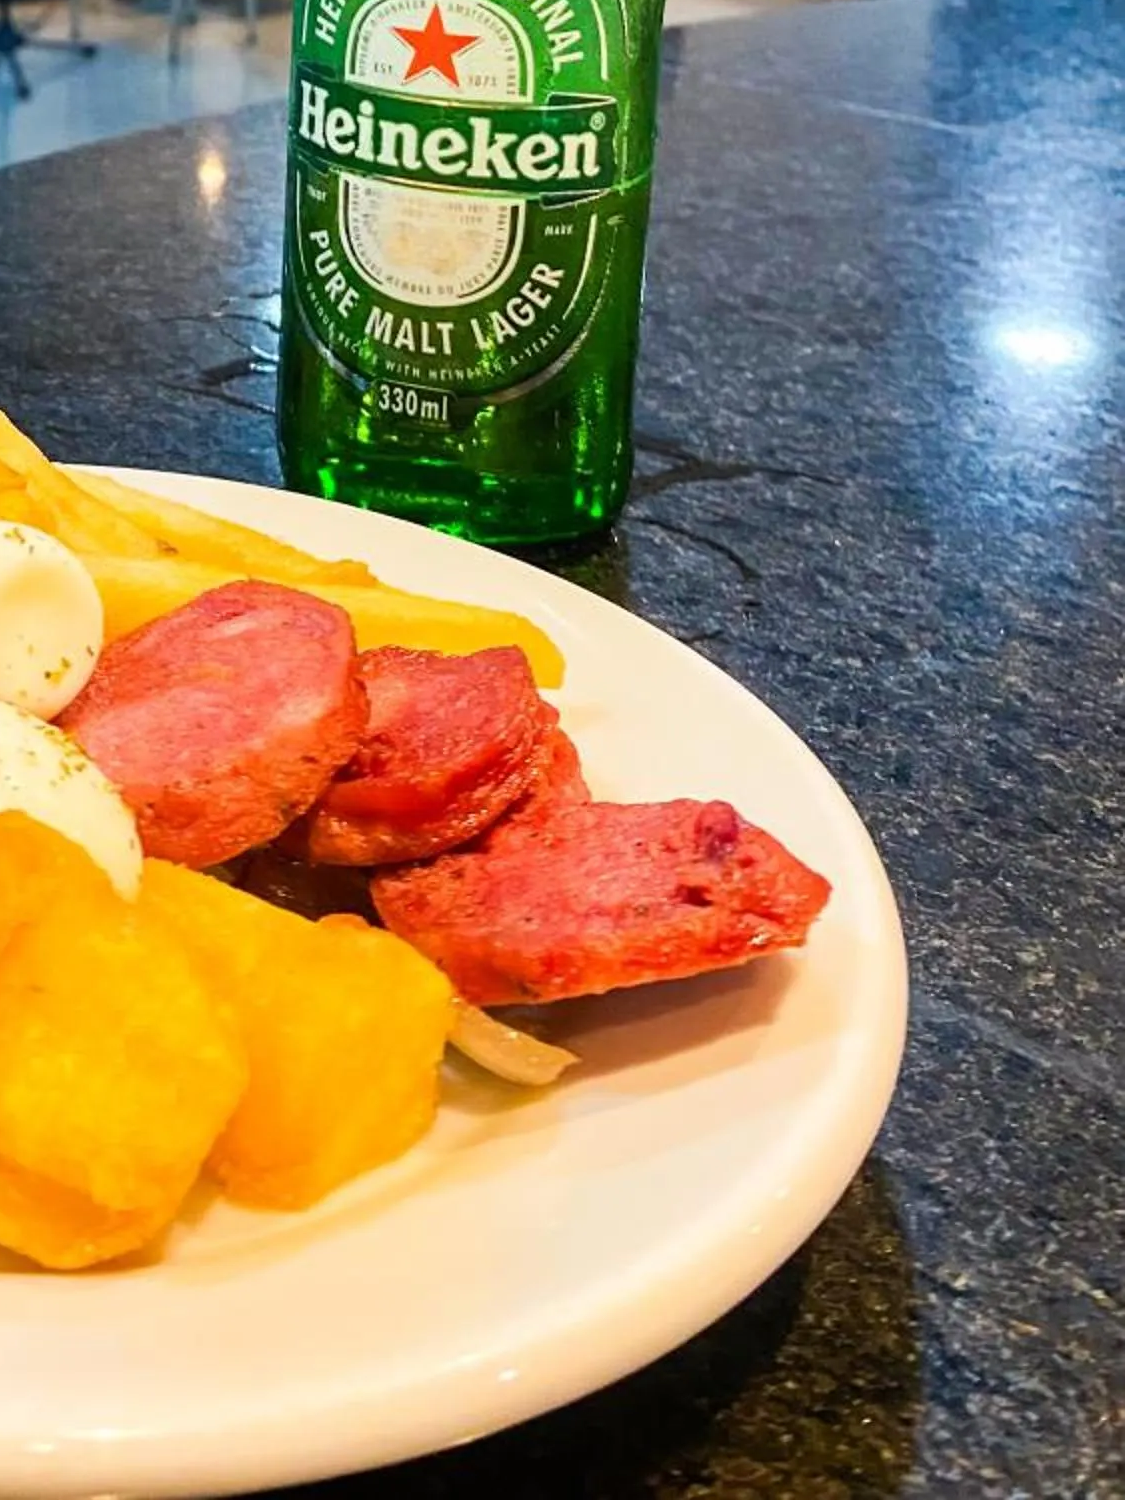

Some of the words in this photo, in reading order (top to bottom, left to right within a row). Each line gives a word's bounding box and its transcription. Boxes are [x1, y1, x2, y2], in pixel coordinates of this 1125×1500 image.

[298, 79, 602, 181] Heineken
[309, 229, 360, 319] PURE
[364, 304, 455, 357] MALT
[470, 261, 565, 350] LAGER
[378, 383, 448, 421] 330ml
[385, 360, 421, 378] WITH
